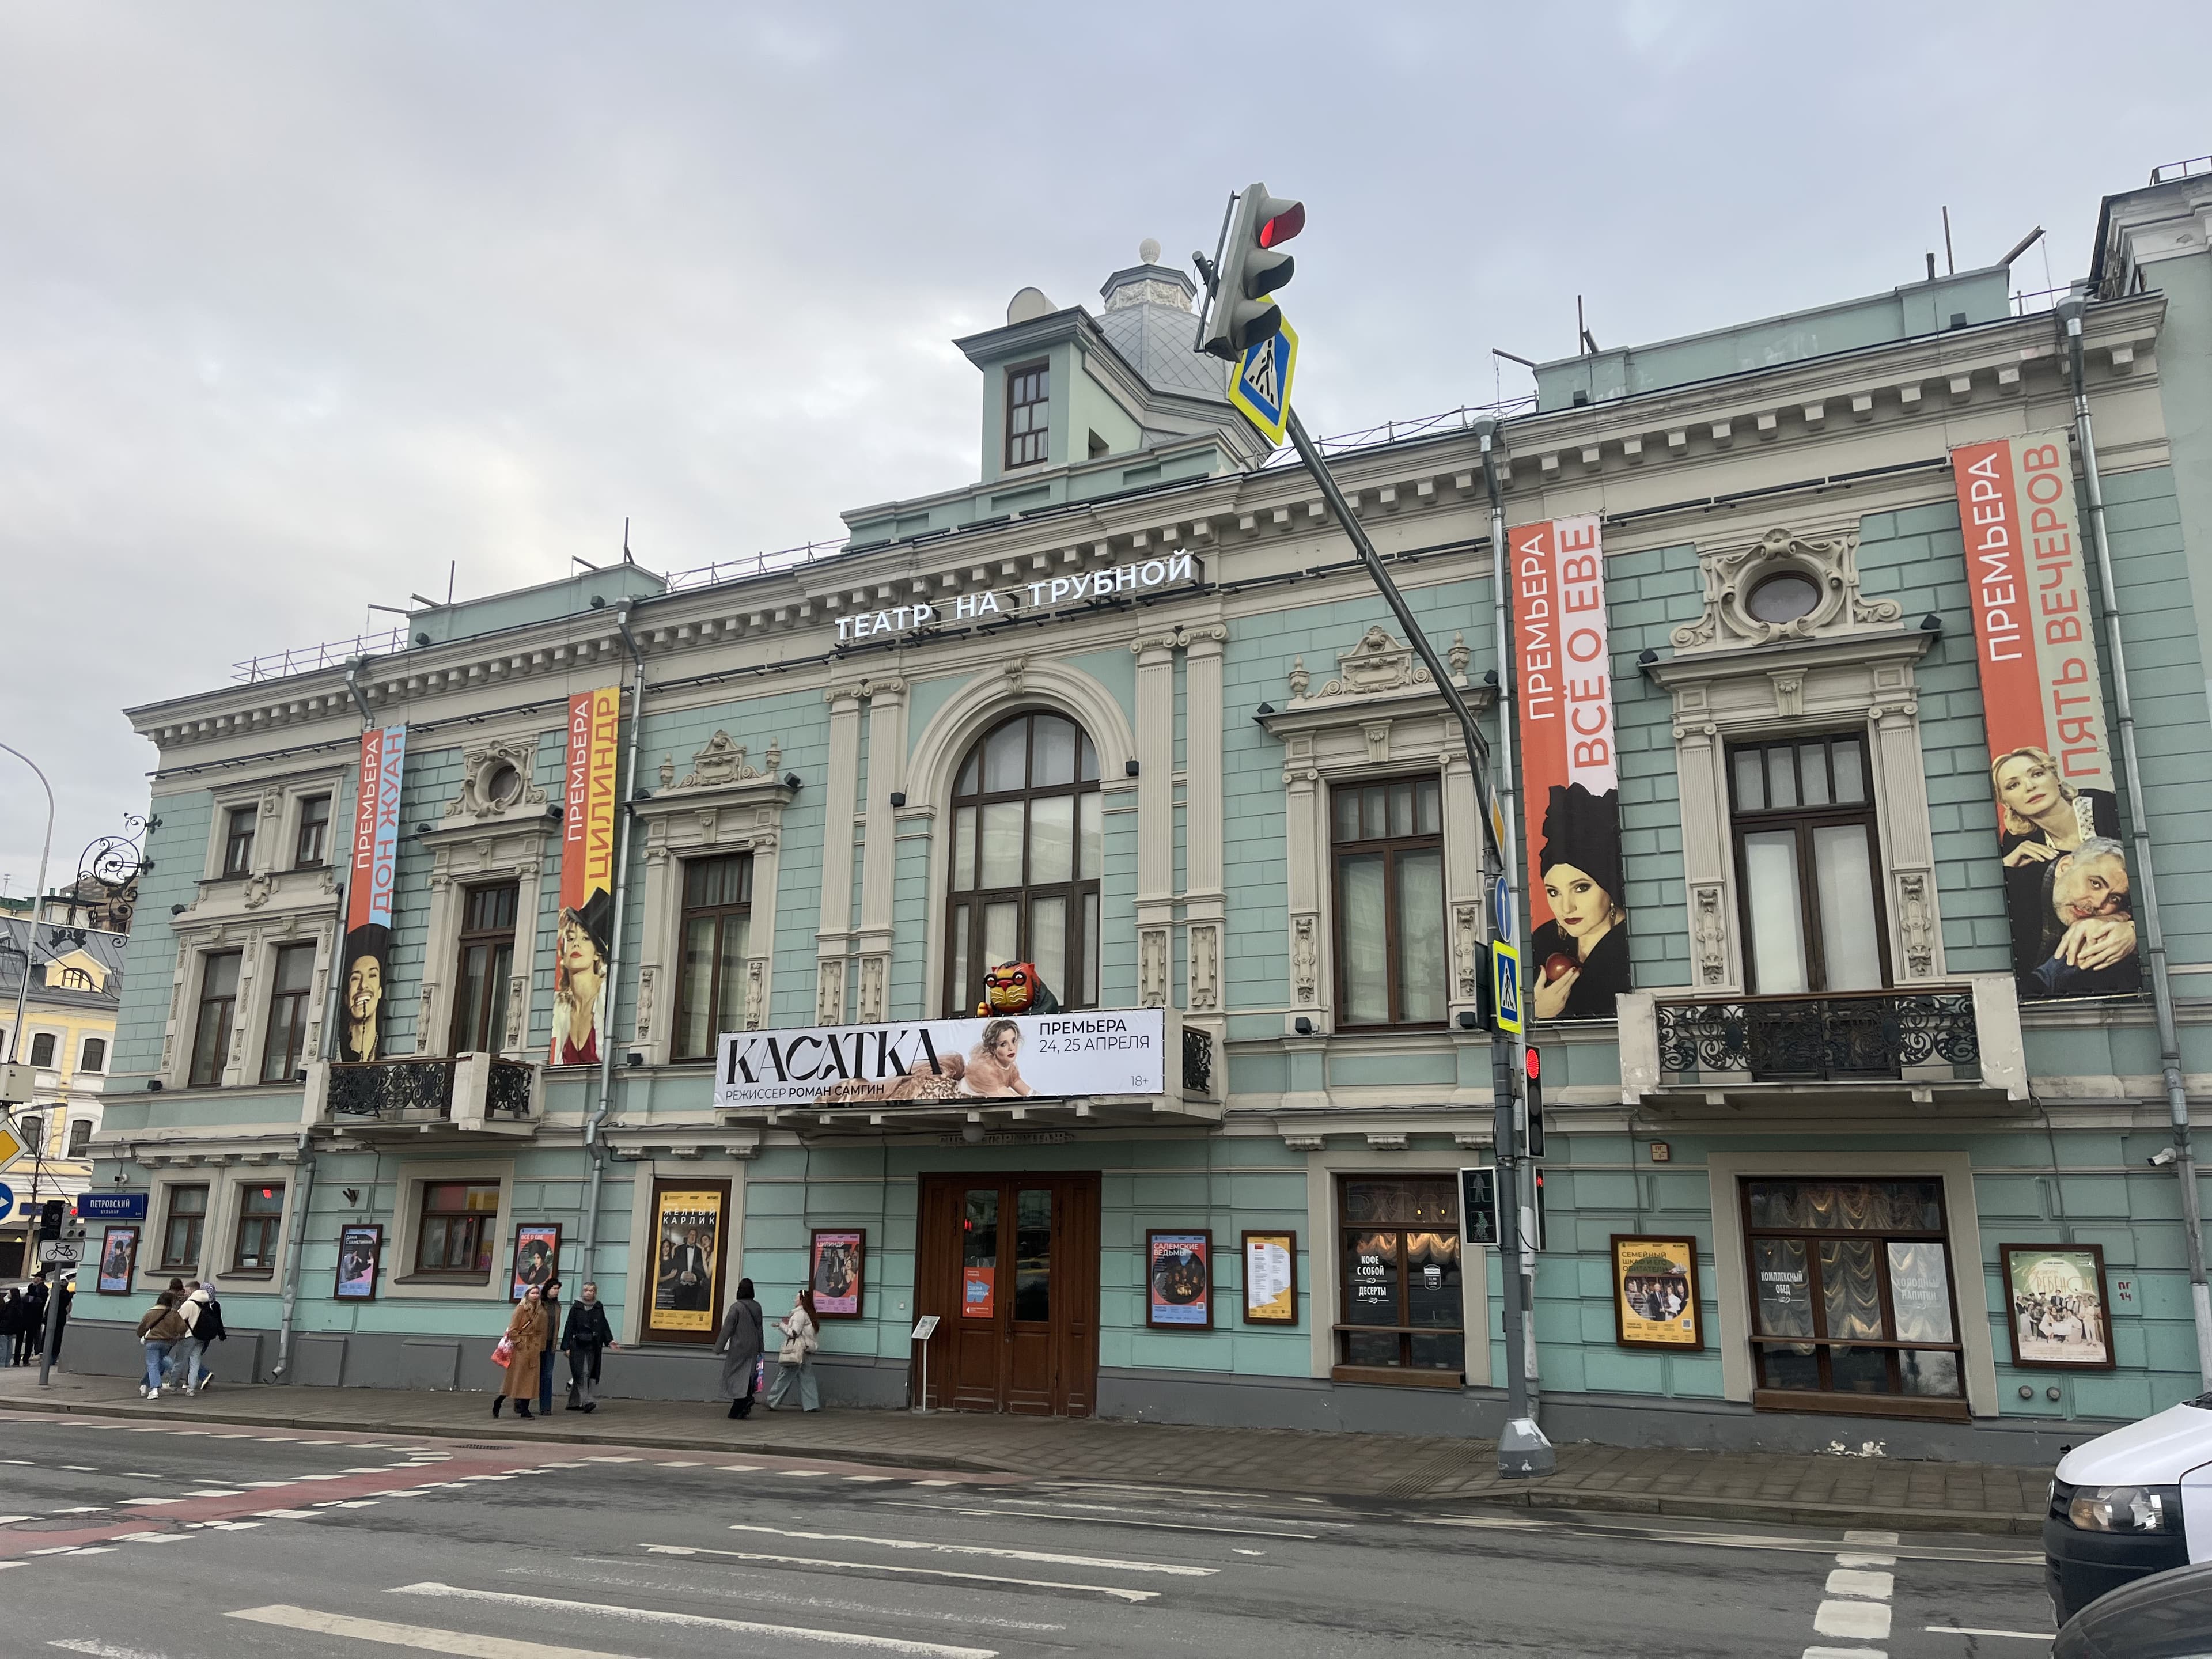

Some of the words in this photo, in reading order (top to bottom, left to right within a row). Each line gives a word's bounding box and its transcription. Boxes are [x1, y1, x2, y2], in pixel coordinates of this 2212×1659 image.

[1968, 453, 2023, 662] ПРЕМЬЕРА
[2023, 444, 2082, 645] ВЕЧЕРОВ
[1560, 525, 1600, 613] ЕВЕ
[835, 603, 933, 640] ТЕАТР
[956, 592, 1000, 619] НА
[1028, 548, 1193, 607] ТРУБНОЙ
[1520, 533, 1555, 721] ПРЕМЬЕРА
[1567, 628, 1602, 662] О
[2052, 657, 2101, 777] ПЯТЬ
[379, 733, 403, 829] ЖУАН
[567, 700, 589, 842] ПРЕМЬЕРА
[589, 696, 619, 879] ЦИЛИНДР
[357, 737, 379, 869] ПРЕМЬЕРА
[373, 839, 395, 914] ДОН
[1040, 1019, 1127, 1035] ПРЕМЬЕРА
[726, 1029, 942, 1084] КАСАТКА
[1040, 1039, 1060, 1054] 24,
[1064, 1039, 1080, 1051] 25
[1084, 1035, 1149, 1051] АПРЕЛЯ
[726, 1088, 786, 1101] РЕЖИССЕР
[789, 1086, 831, 1098] РОМАН
[835, 1084, 884, 1096] САМГИН
[1131, 1075, 1149, 1086] 18+
[90, 1199, 130, 1208] ПЕТРОВСКИЙ
[663, 1217, 715, 1225] КАРЛИК
[1357, 1267, 1361, 1275] С
[1363, 1266, 1384, 1276] СОБОЙ
[1361, 1256, 1379, 1264] КОФЕ
[1761, 1270, 1803, 1282] КОМПЛЕКСНЫЙ
[2118, 1282, 2131, 1290] ПГ
[1359, 1286, 1387, 1297] ДЕСЕРТЫ
[1775, 1284, 1791, 1296] ОБЕД
[1901, 1290, 1937, 1300] НАПИТКИ
